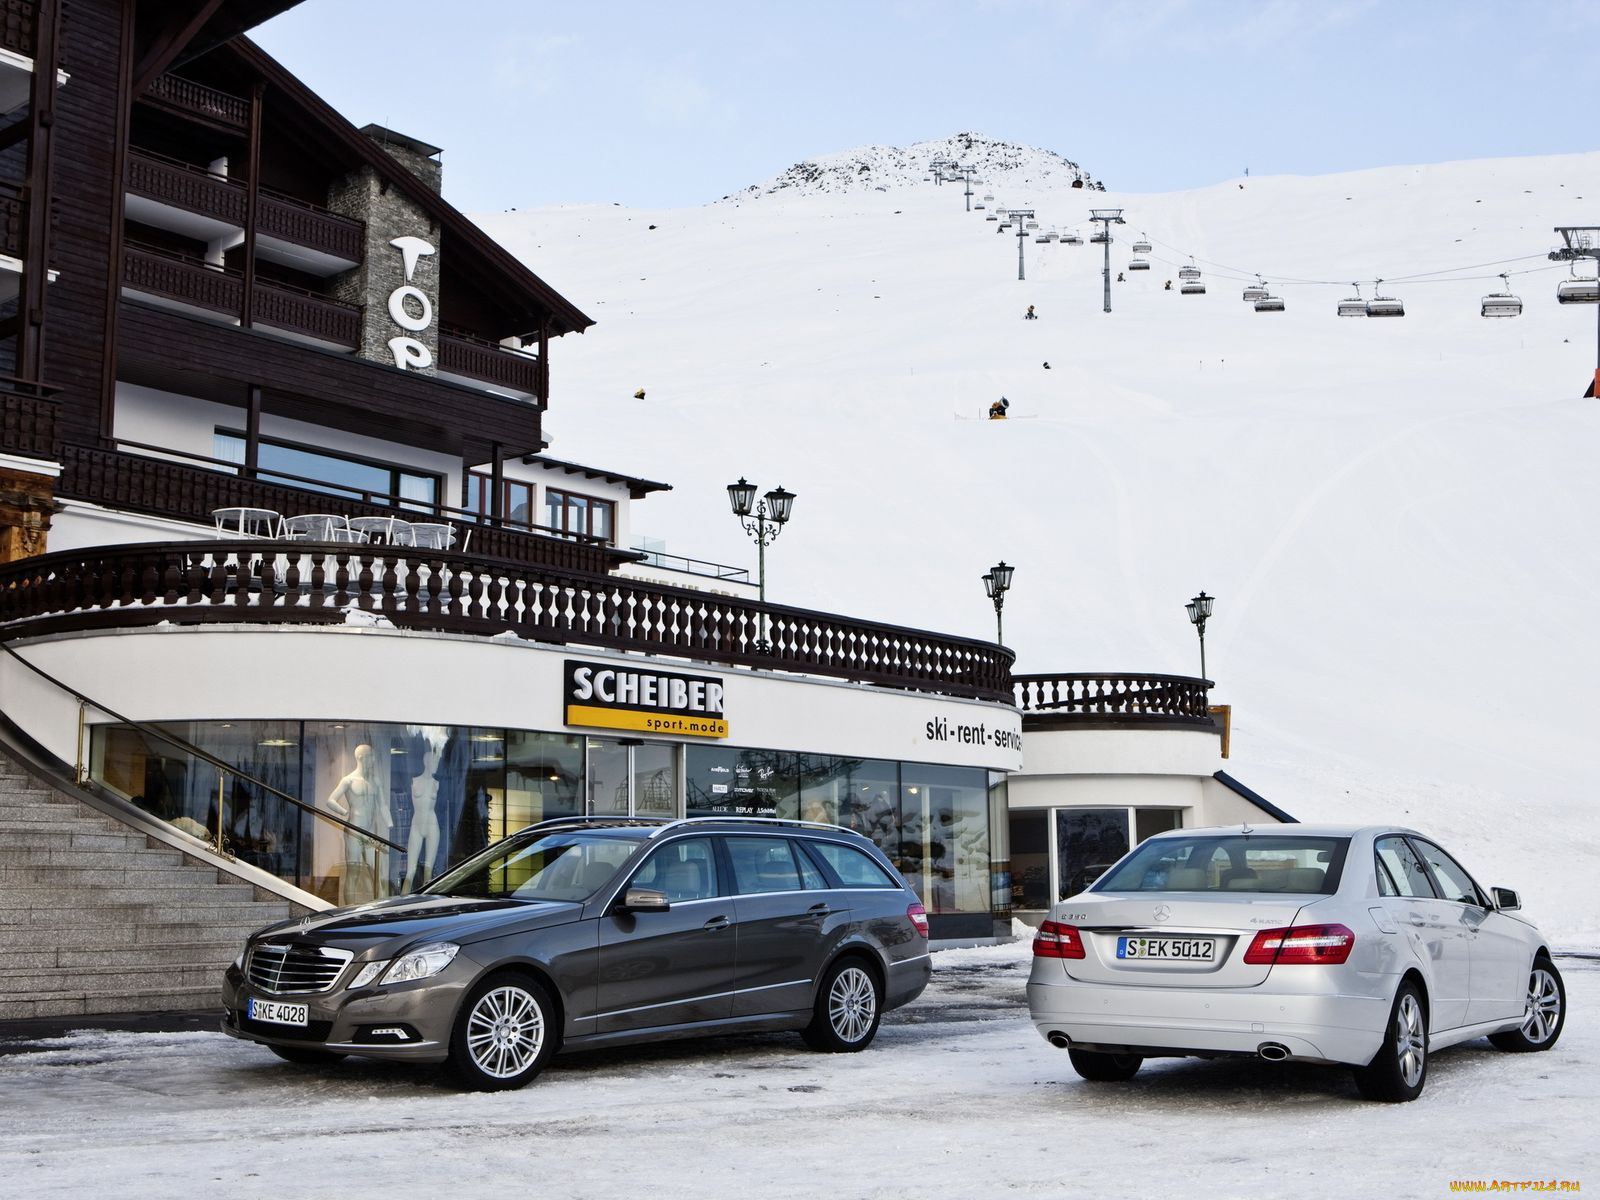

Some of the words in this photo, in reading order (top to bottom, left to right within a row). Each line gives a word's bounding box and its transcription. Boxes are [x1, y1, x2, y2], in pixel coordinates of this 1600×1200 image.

[388, 236, 436, 370] TOP
[573, 667, 723, 713] SCHEIBER
[647, 718, 725, 733] sport.mode
[1127, 940, 1138, 956] S
[1147, 940, 1169, 957] EK
[1171, 941, 1212, 958] 5012
[253, 1001, 258, 1017] S
[262, 1003, 275, 1020] KE
[276, 1005, 305, 1023] 4028
